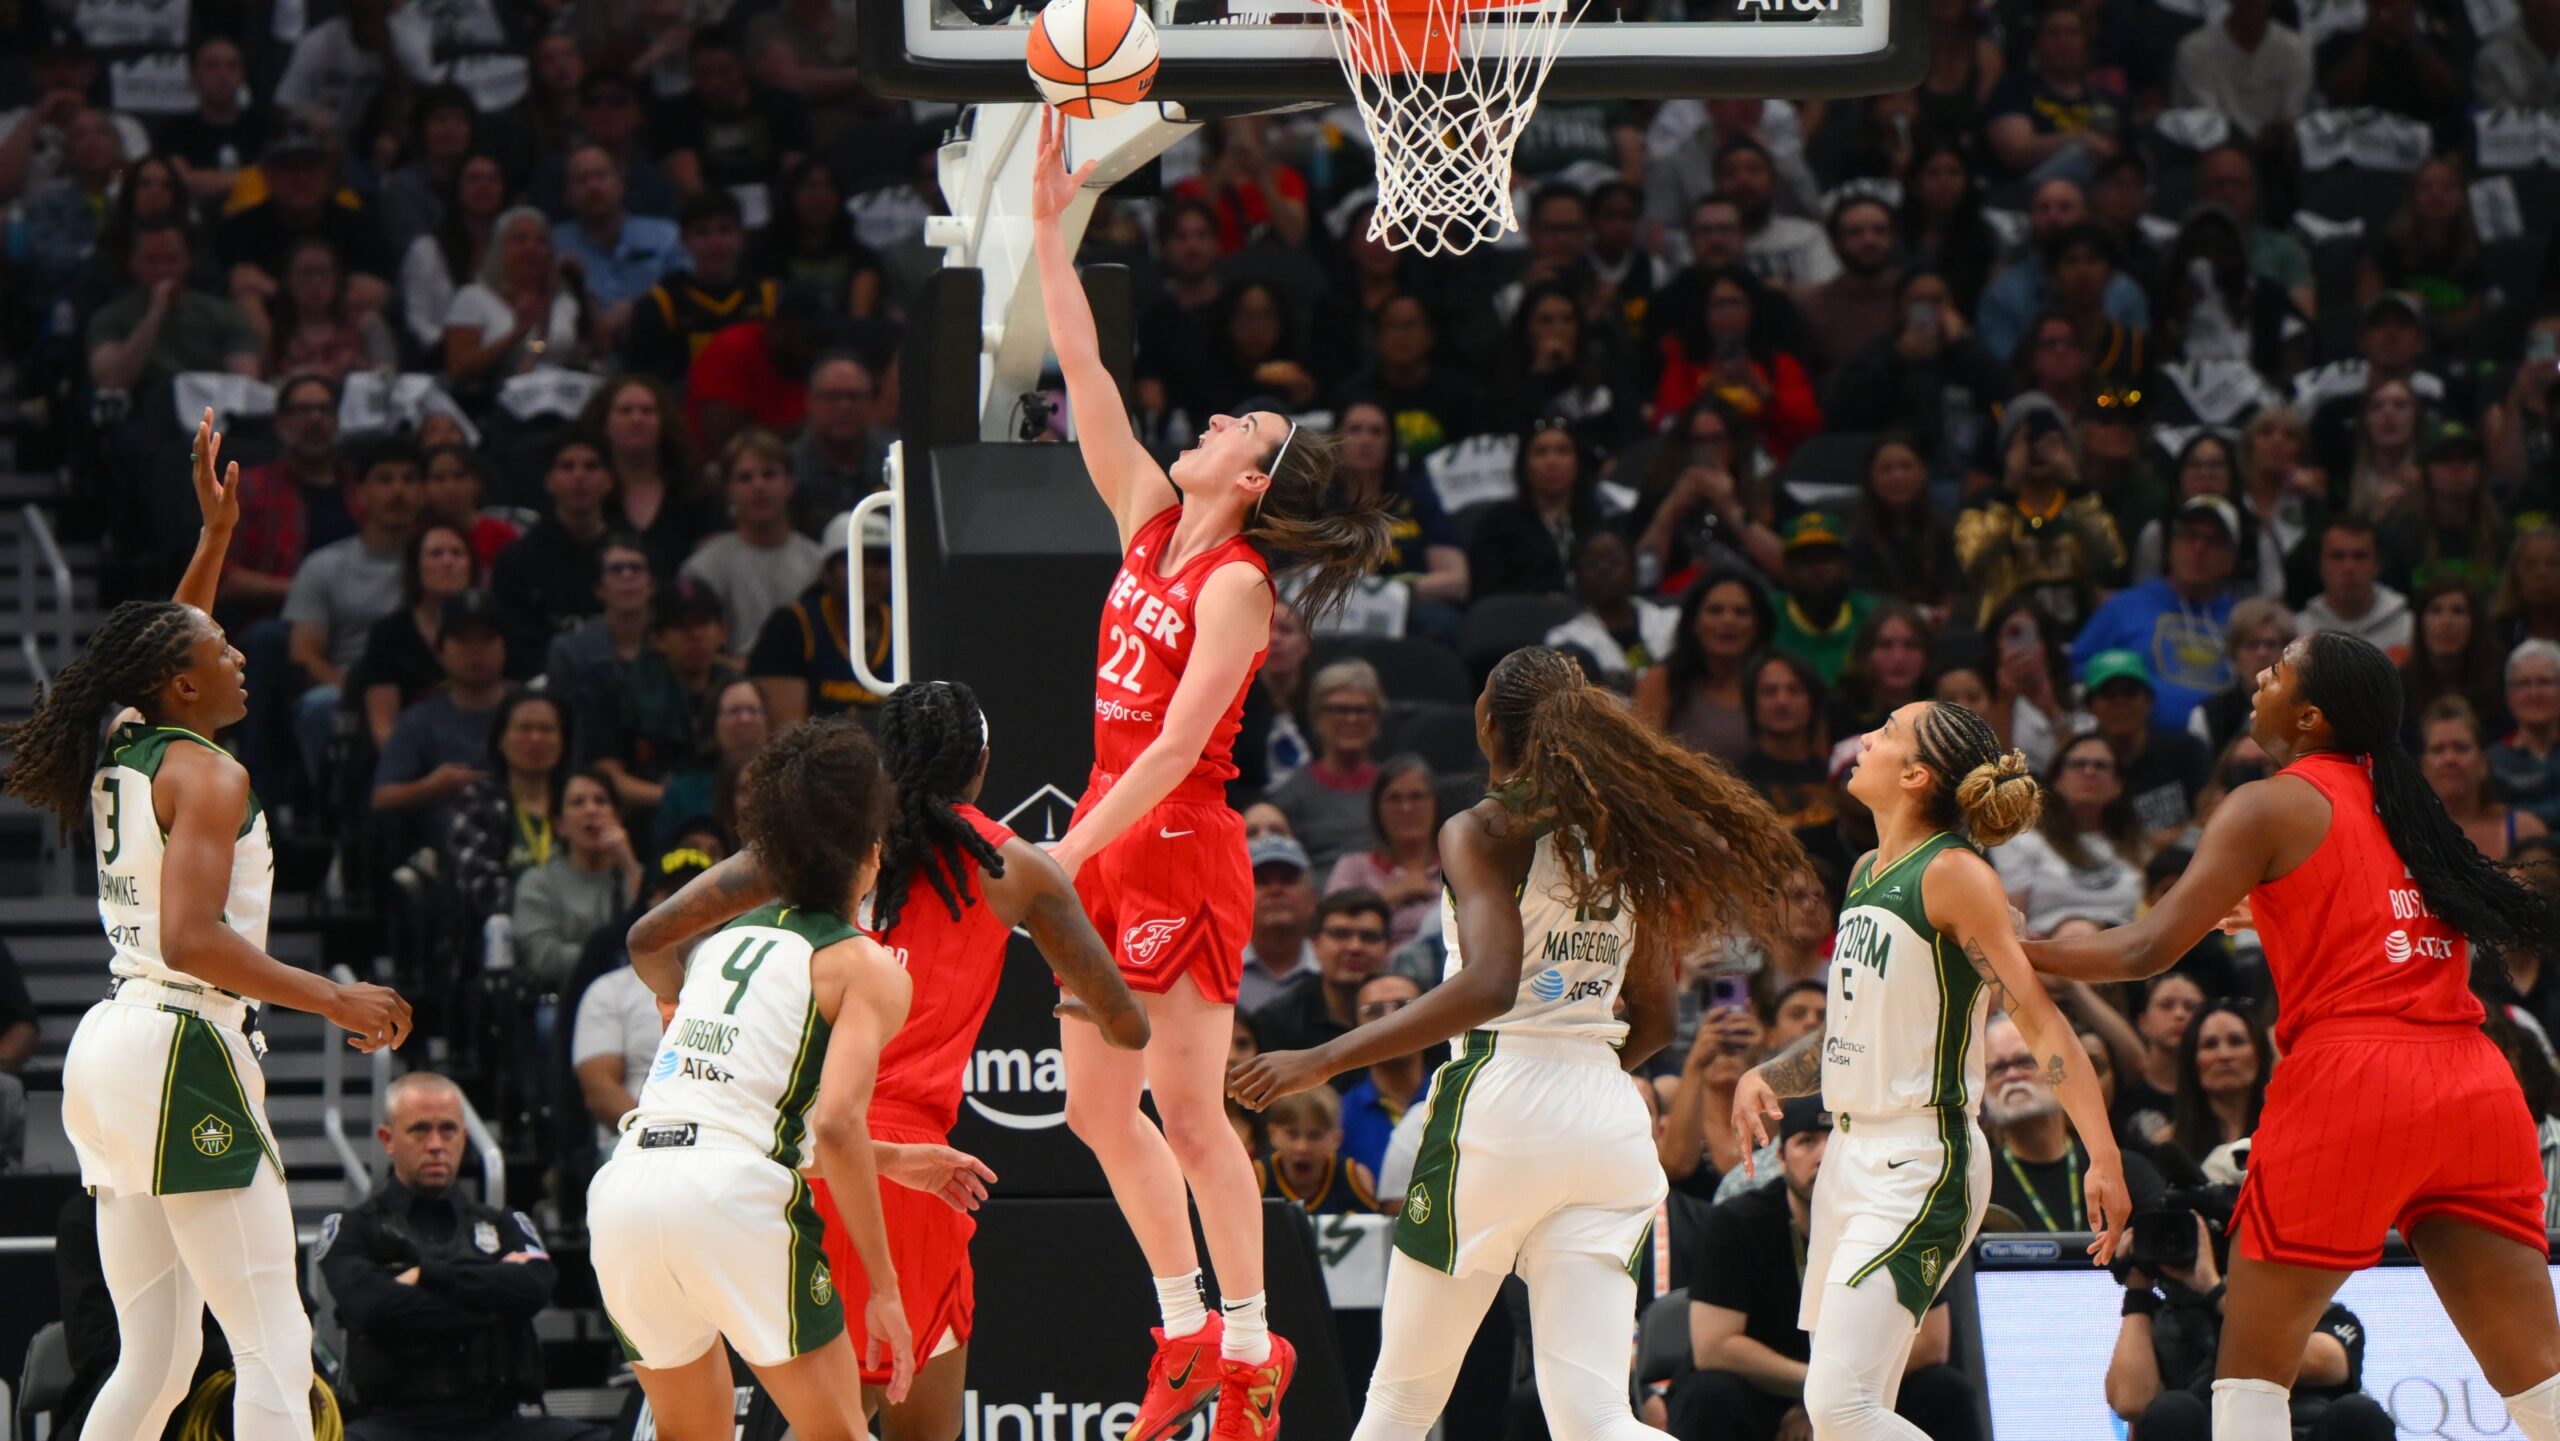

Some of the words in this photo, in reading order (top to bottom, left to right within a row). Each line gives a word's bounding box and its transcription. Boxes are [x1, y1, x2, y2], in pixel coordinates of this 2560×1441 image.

[1099, 624, 1146, 694] 22
[102, 777, 120, 865] 3
[2388, 888, 2439, 920] BOS
[1541, 930, 1619, 966] MAGBEGOR
[721, 936, 778, 1015] 4
[674, 1018, 740, 1056] DIGGINS
[680, 1057, 735, 1083] AT&T
